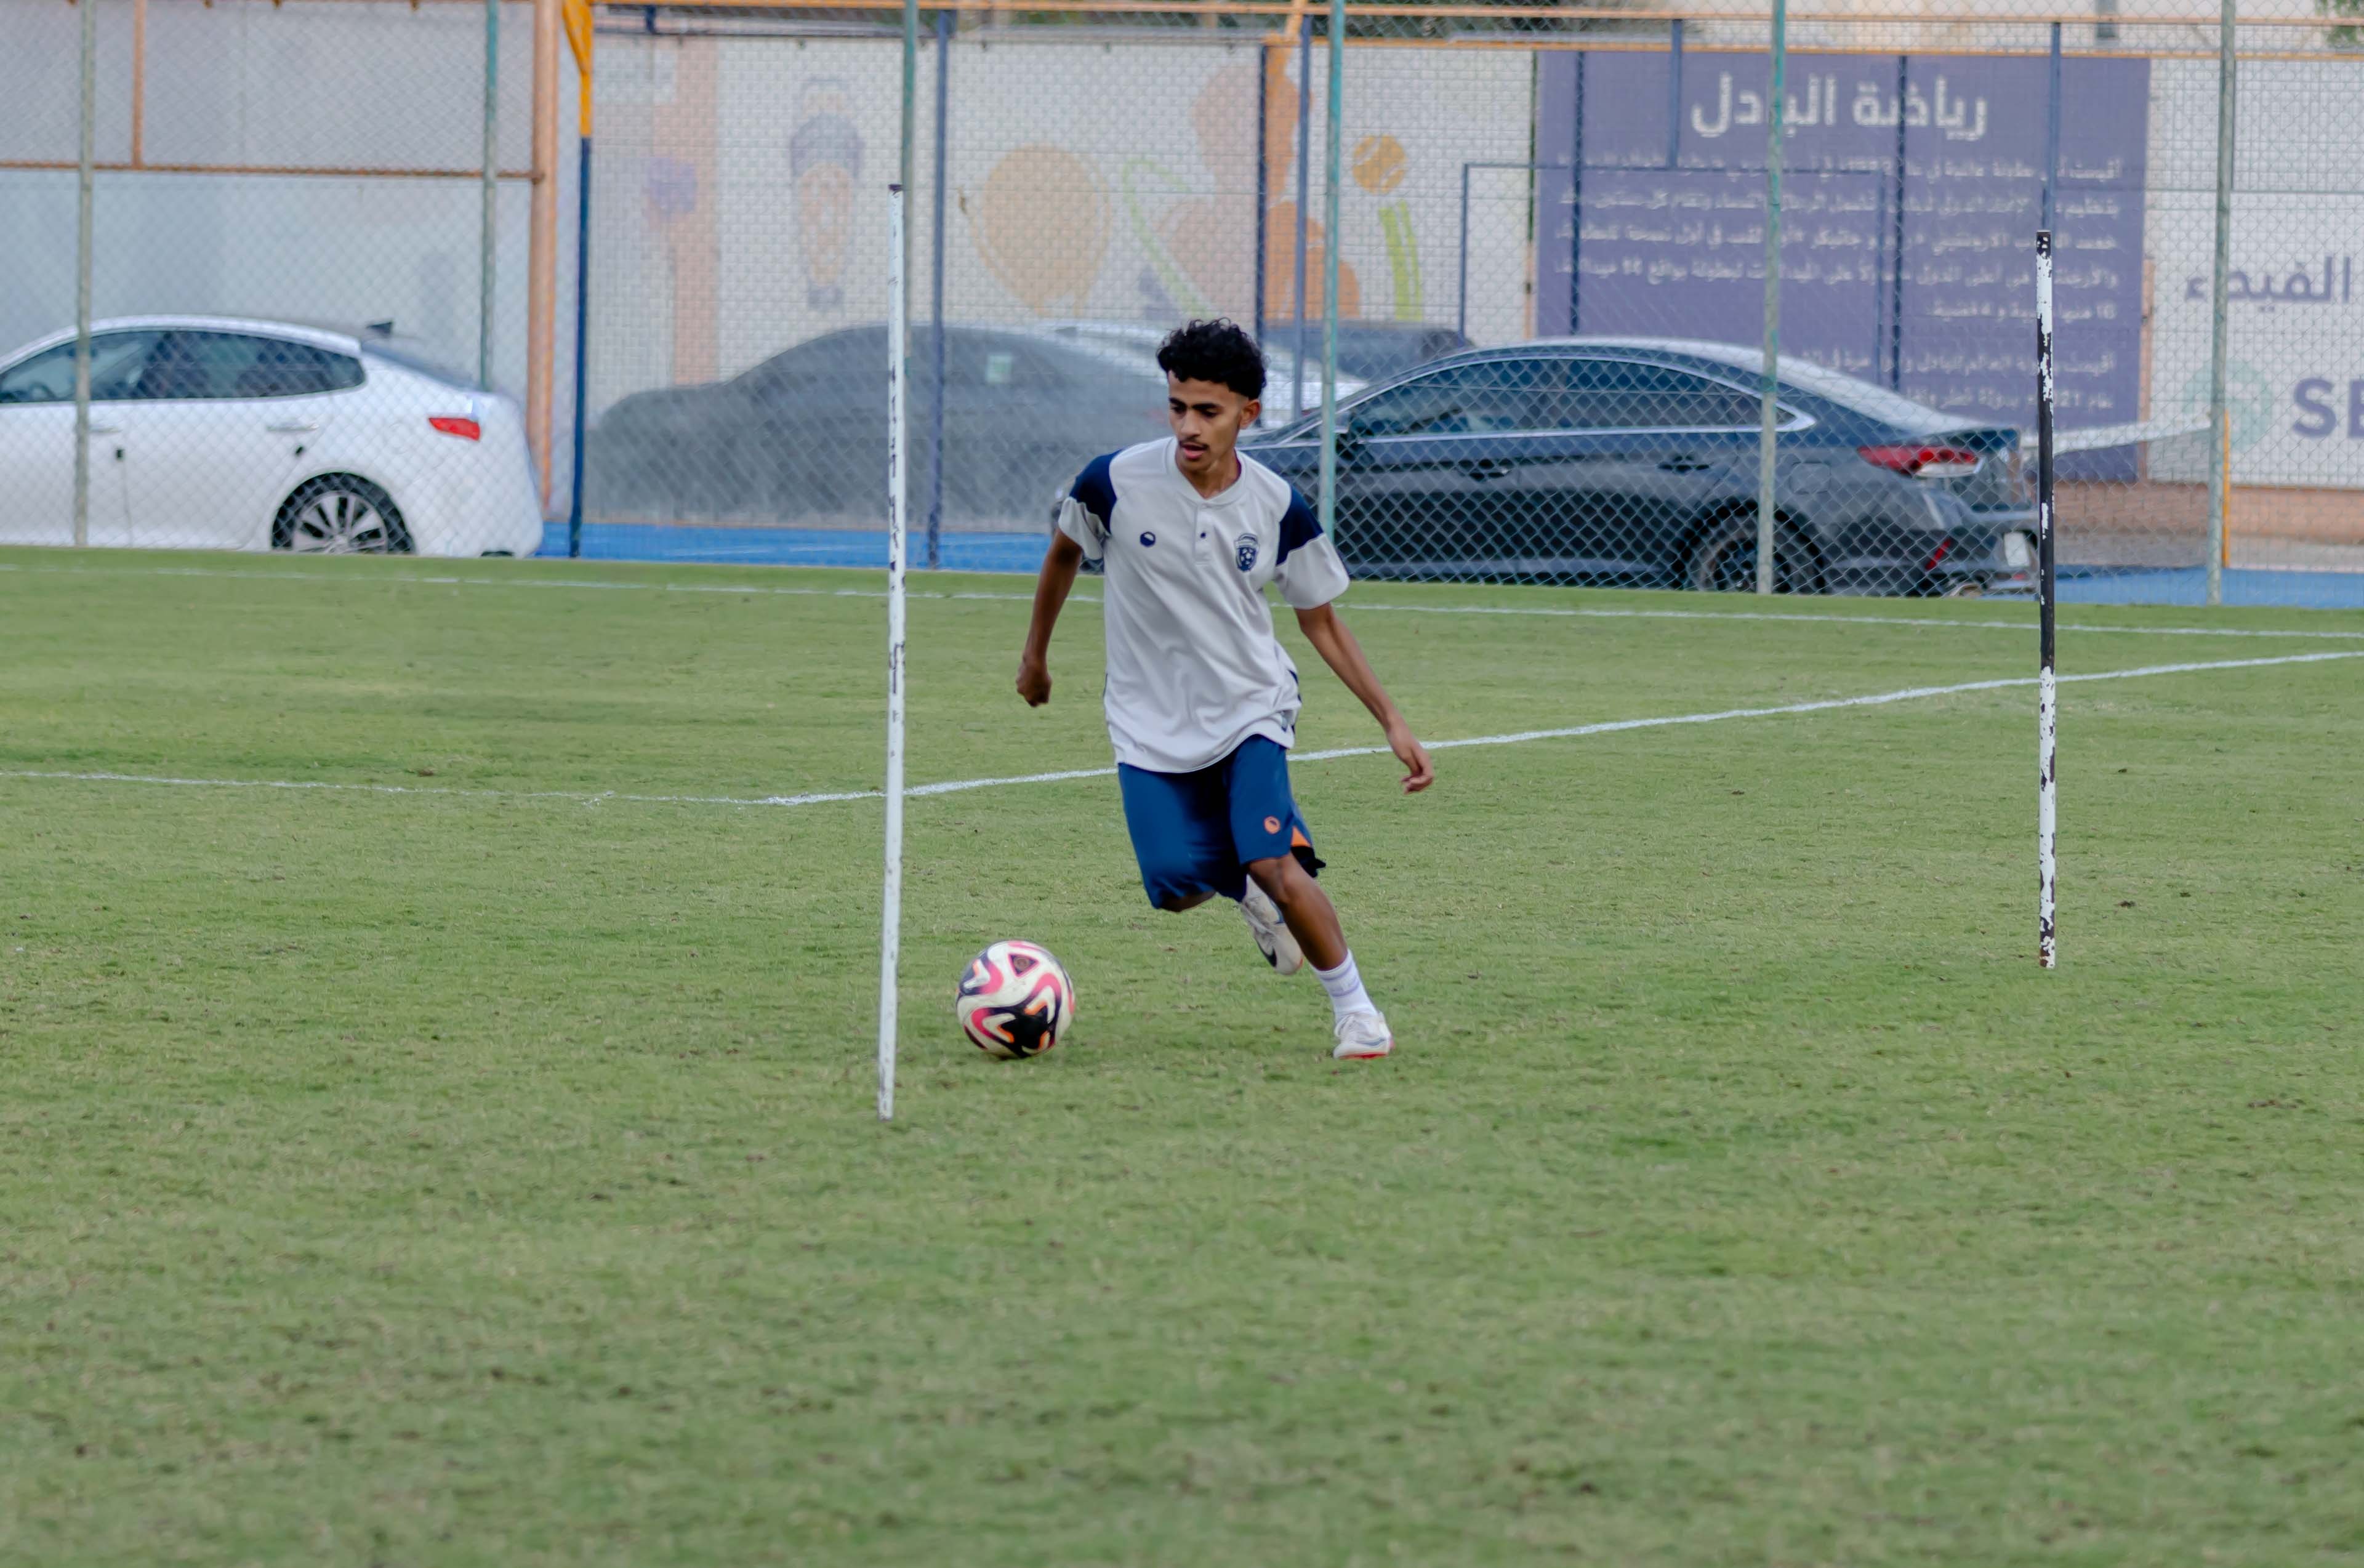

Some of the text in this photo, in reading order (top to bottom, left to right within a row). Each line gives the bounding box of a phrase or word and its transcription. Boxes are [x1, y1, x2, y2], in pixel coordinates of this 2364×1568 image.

[1691, 71, 1988, 141] رياضة البدل
[2185, 255, 2351, 313] الفيحء
